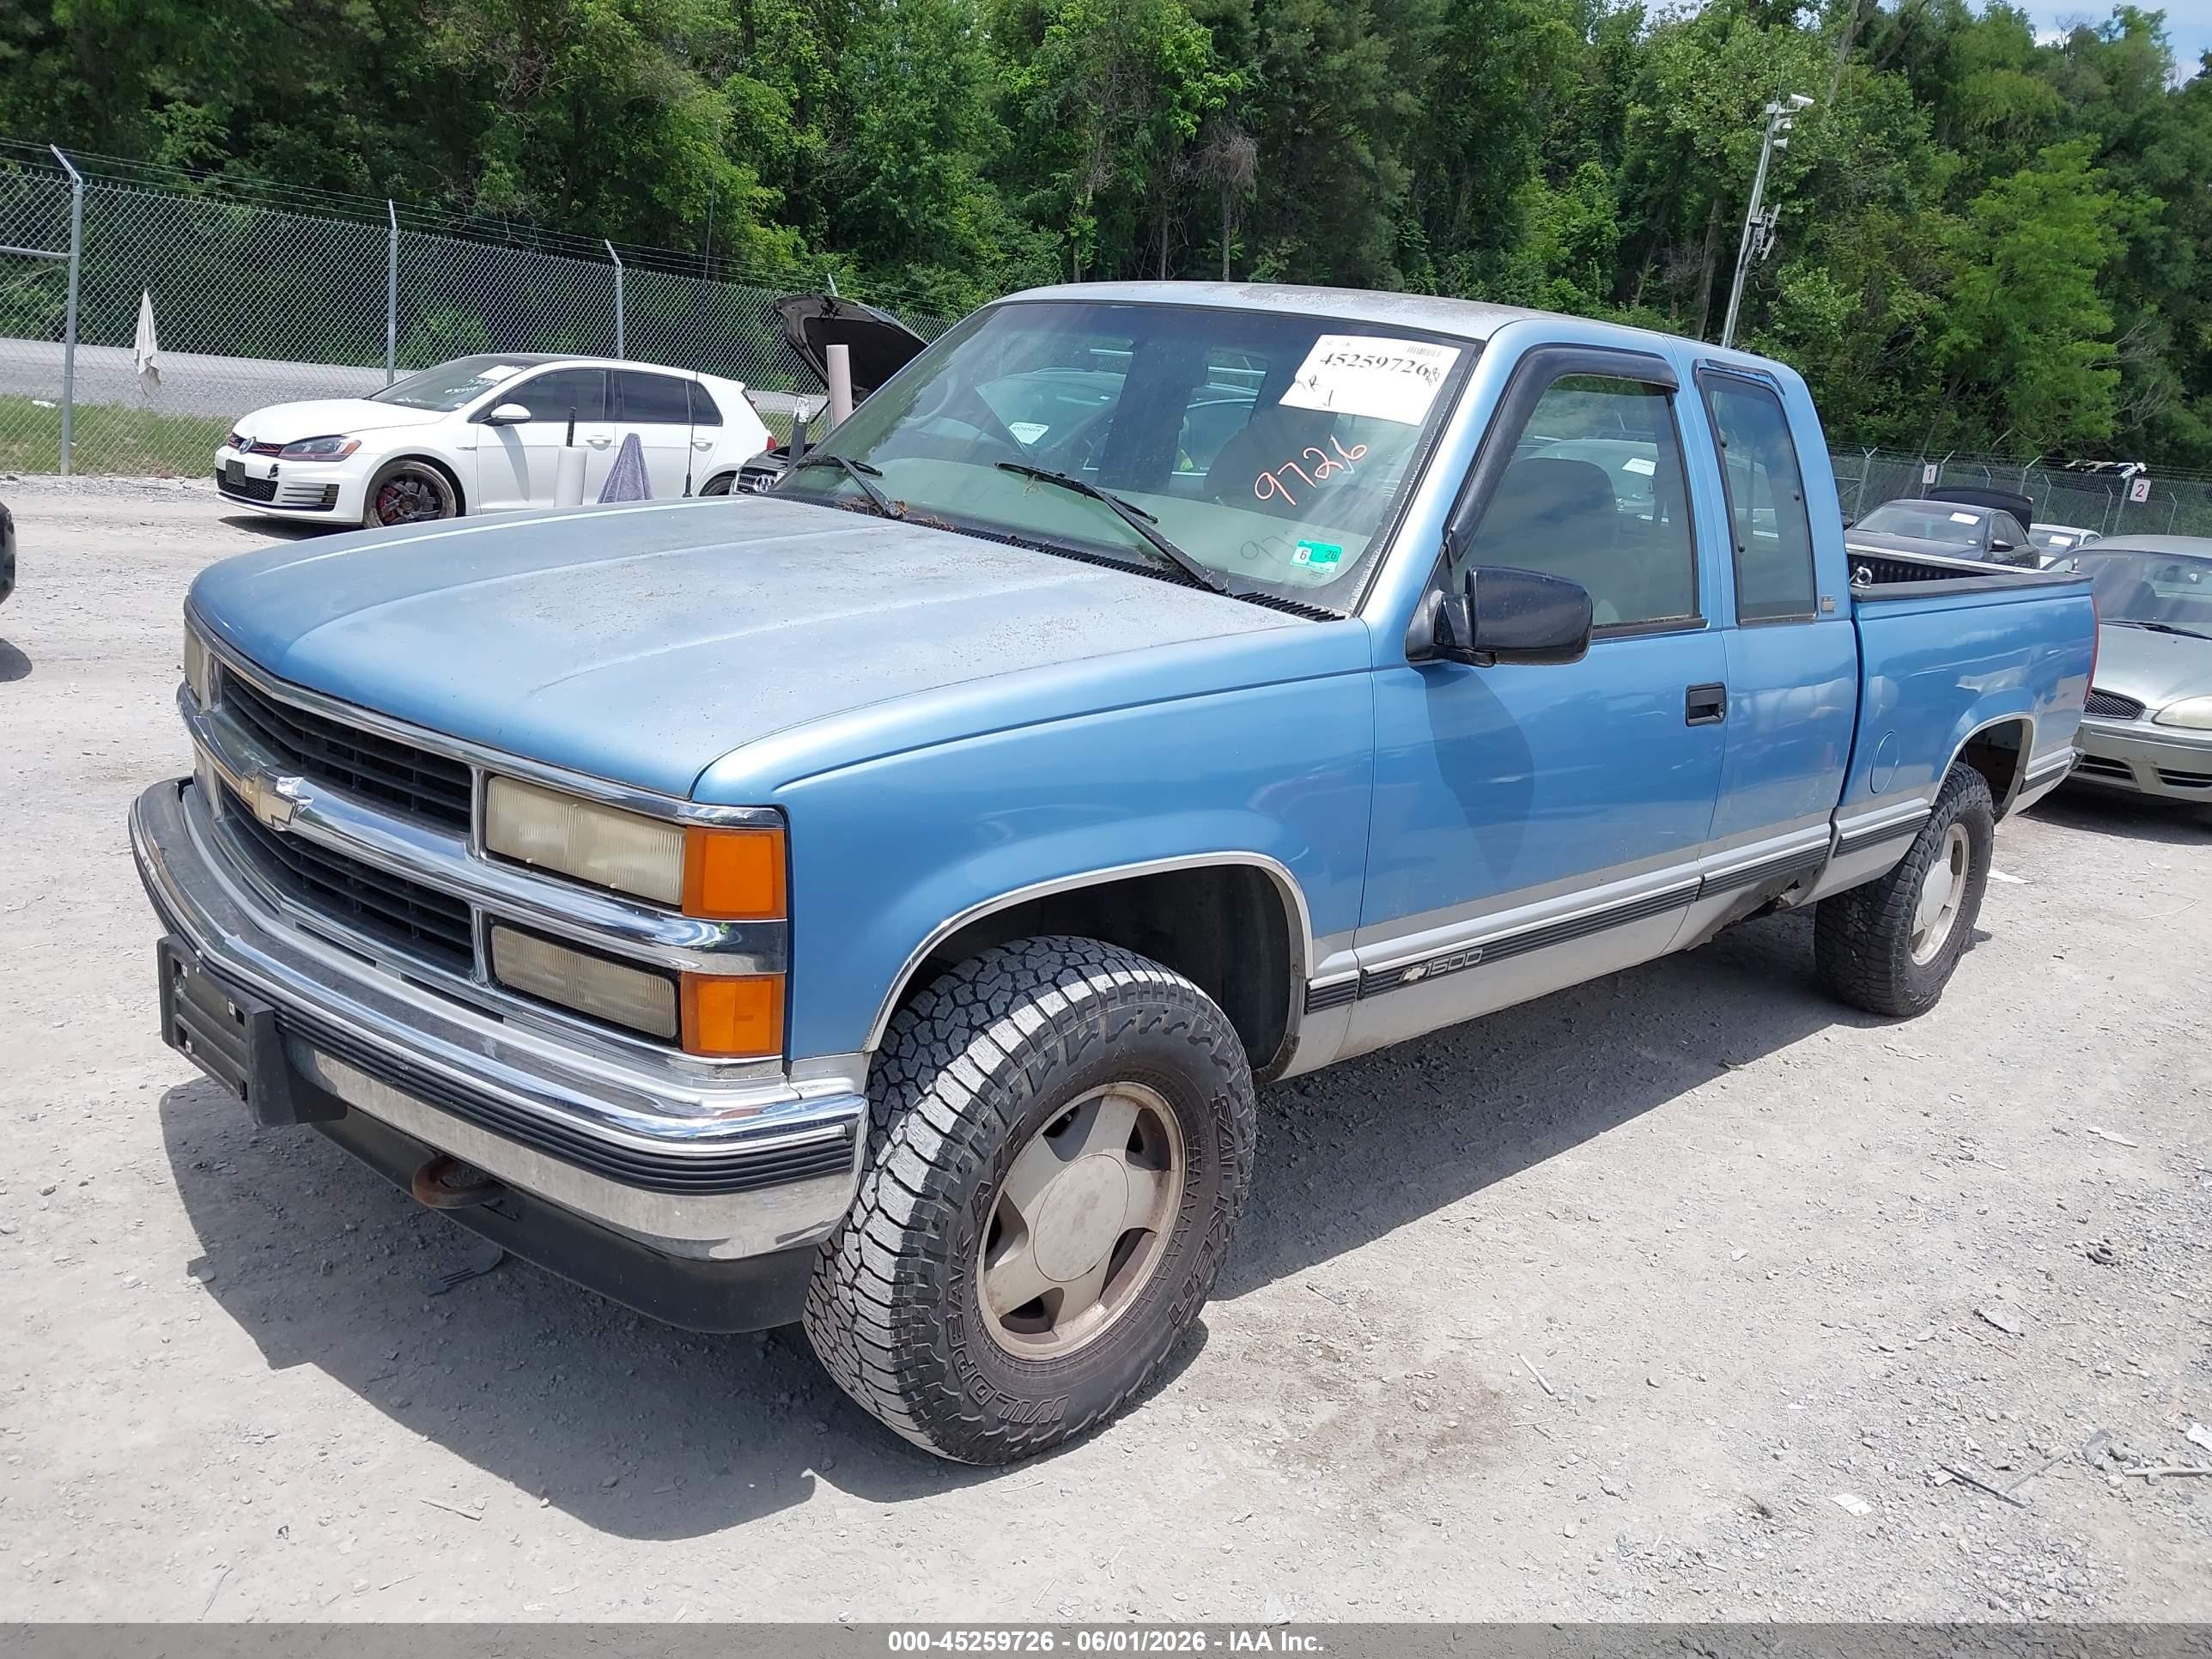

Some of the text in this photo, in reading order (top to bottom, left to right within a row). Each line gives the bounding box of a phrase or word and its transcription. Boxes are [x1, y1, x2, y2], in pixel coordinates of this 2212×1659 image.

[1320, 352, 1432, 378] 45259726
[1254, 433, 1368, 507] 9726
[1928, 468, 1933, 481] 1
[2135, 483, 2145, 498] 2
[1299, 550, 1338, 561] 6 26
[1425, 949, 1484, 977] 1500
[946, 1226, 1070, 1425] WILDPEAK
